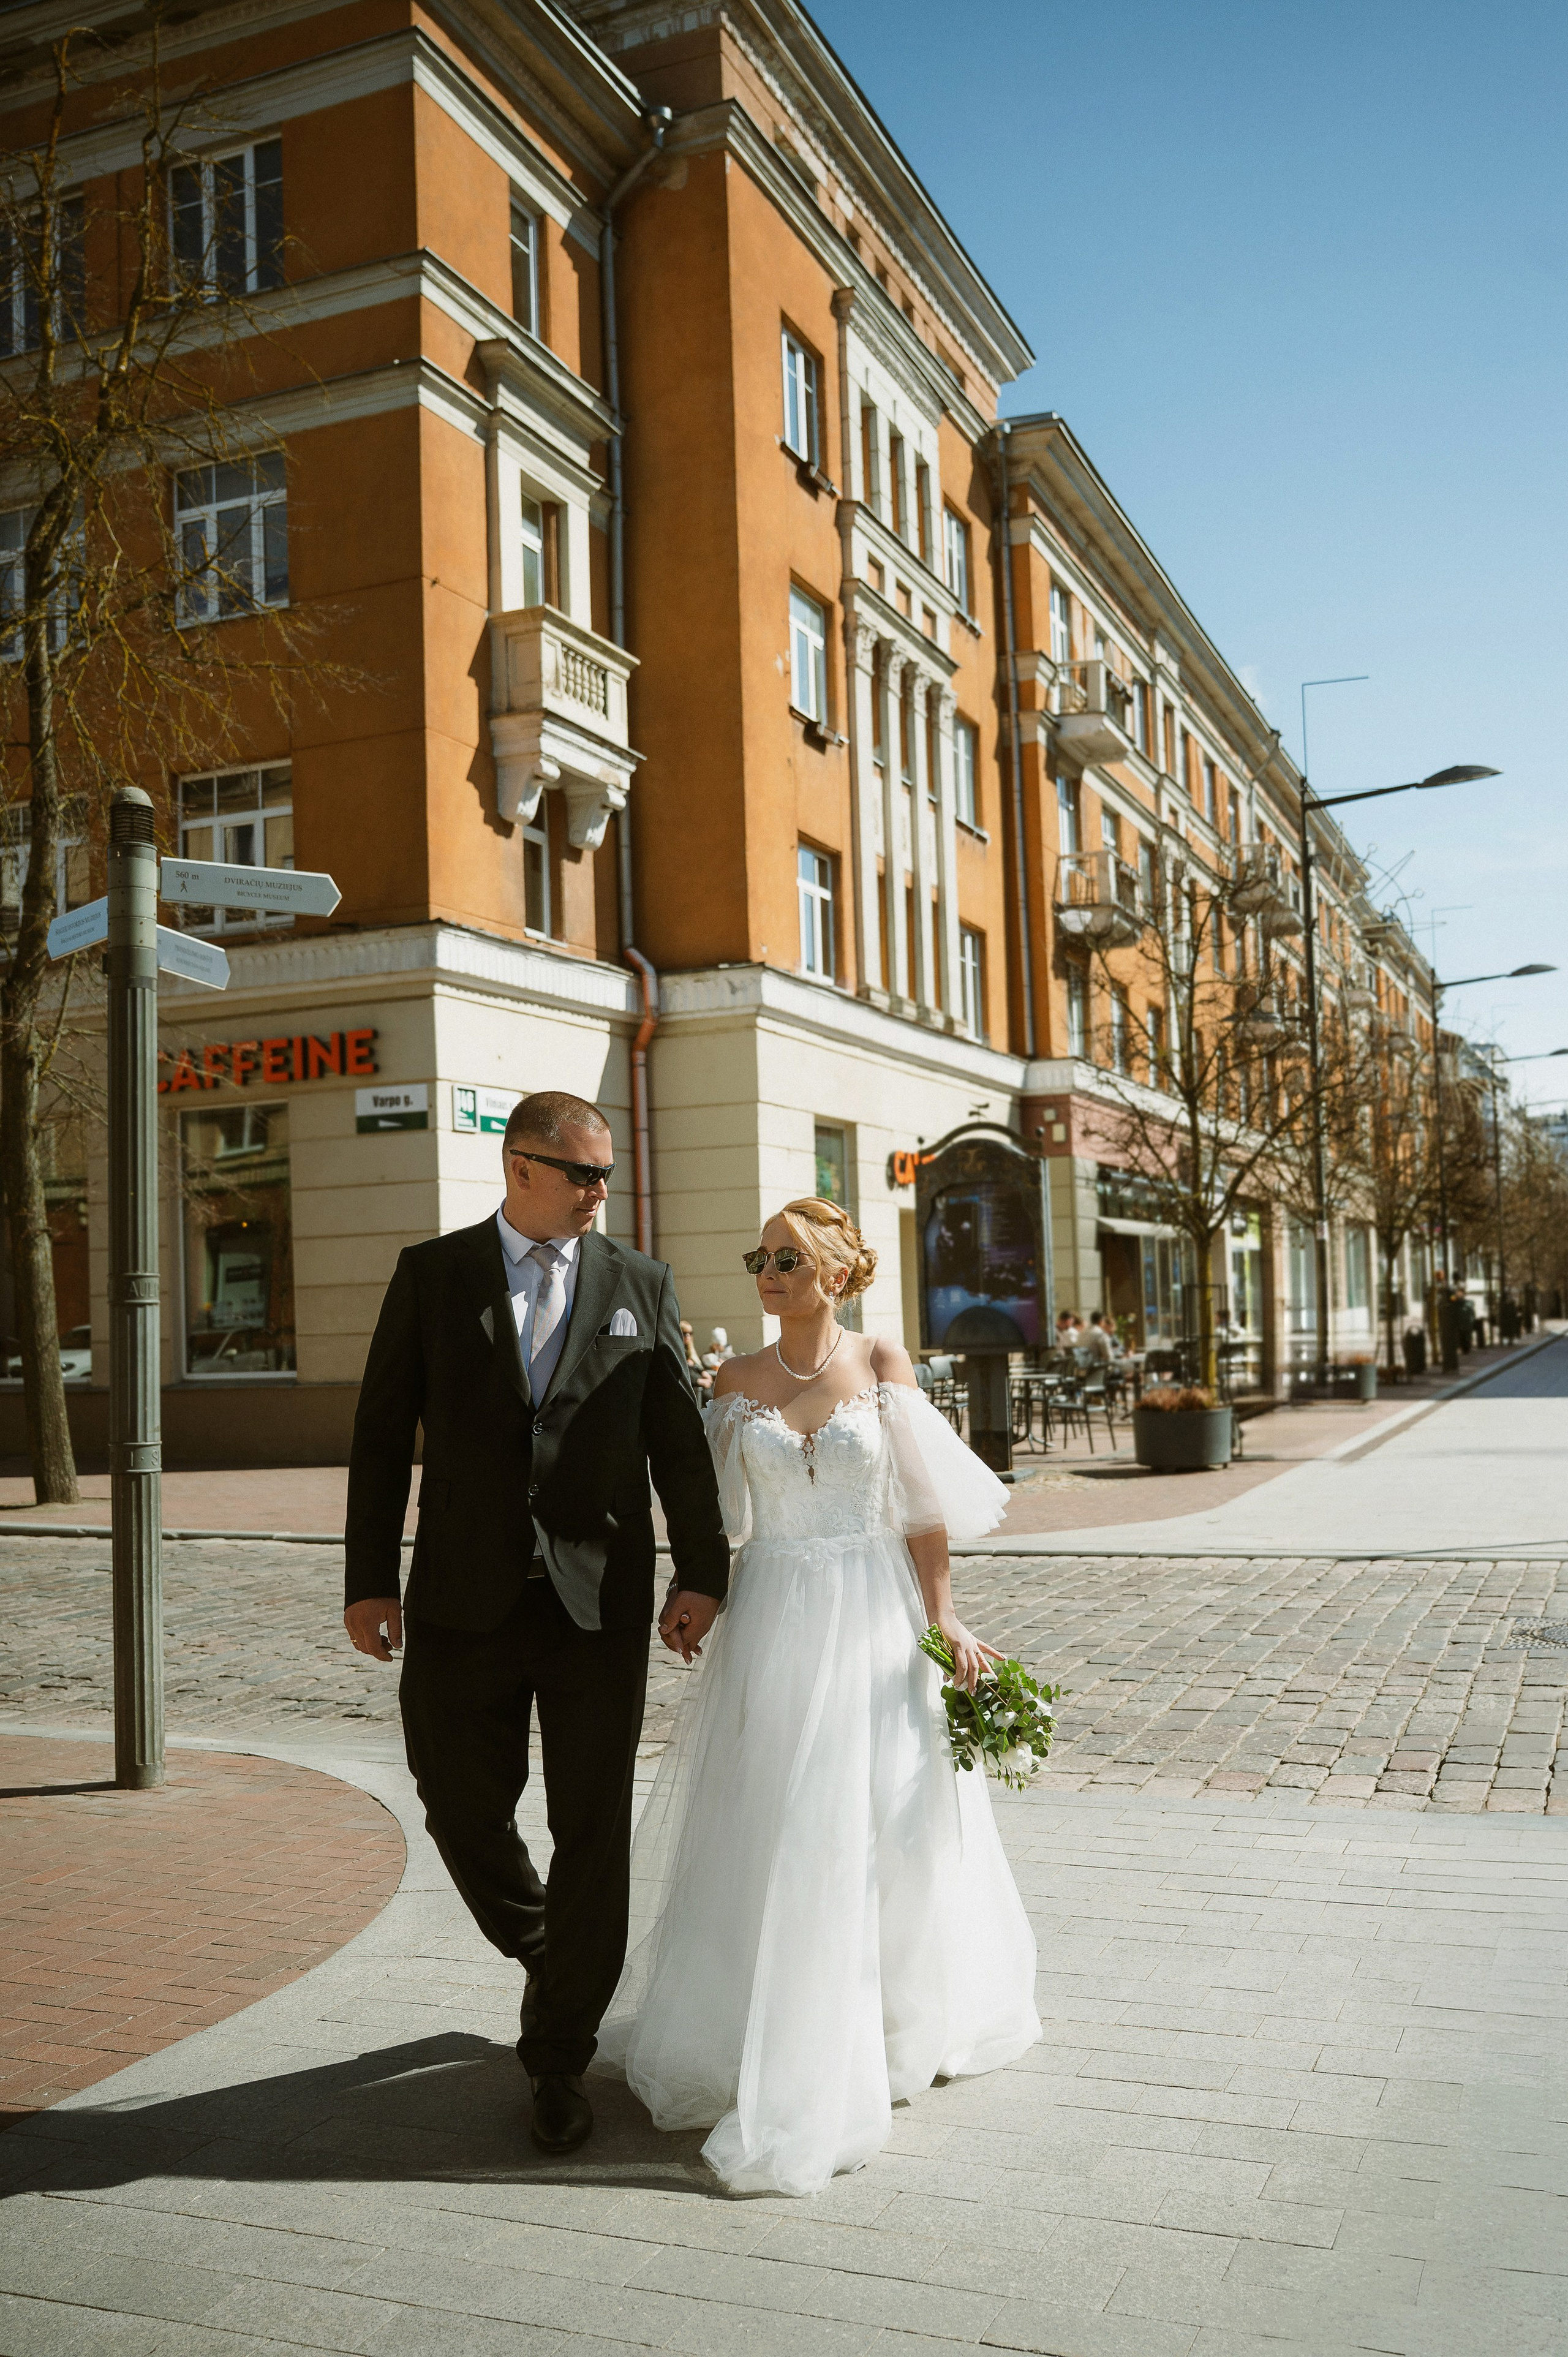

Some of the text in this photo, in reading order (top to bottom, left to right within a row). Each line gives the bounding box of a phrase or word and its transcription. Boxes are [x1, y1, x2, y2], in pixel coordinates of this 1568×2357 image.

[175, 870, 189, 879] 560
[224, 877, 303, 891] DVIRAČIŲ MUZIEJUS
[372, 1095, 413, 1107] Varpo g.
